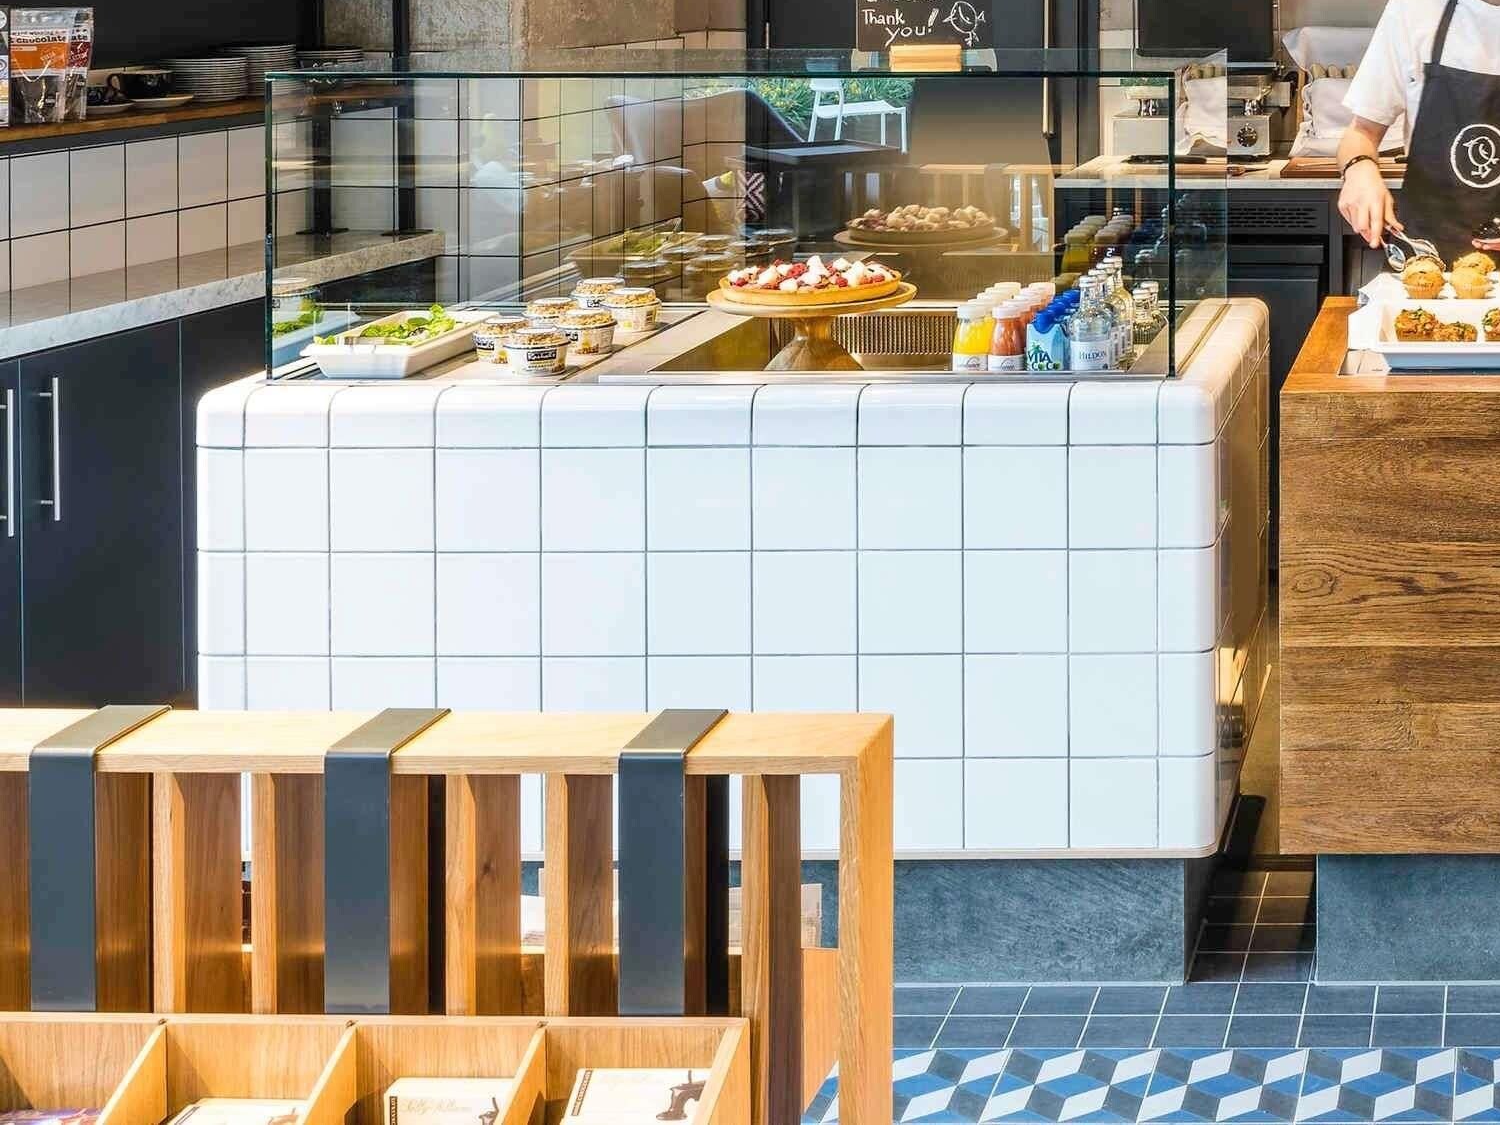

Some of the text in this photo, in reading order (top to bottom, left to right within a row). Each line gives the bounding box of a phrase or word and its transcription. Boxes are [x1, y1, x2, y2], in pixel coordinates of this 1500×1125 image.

[862, 8, 905, 26] Thank
[885, 8, 938, 47] you!
[1028, 352, 1053, 363] VITA
